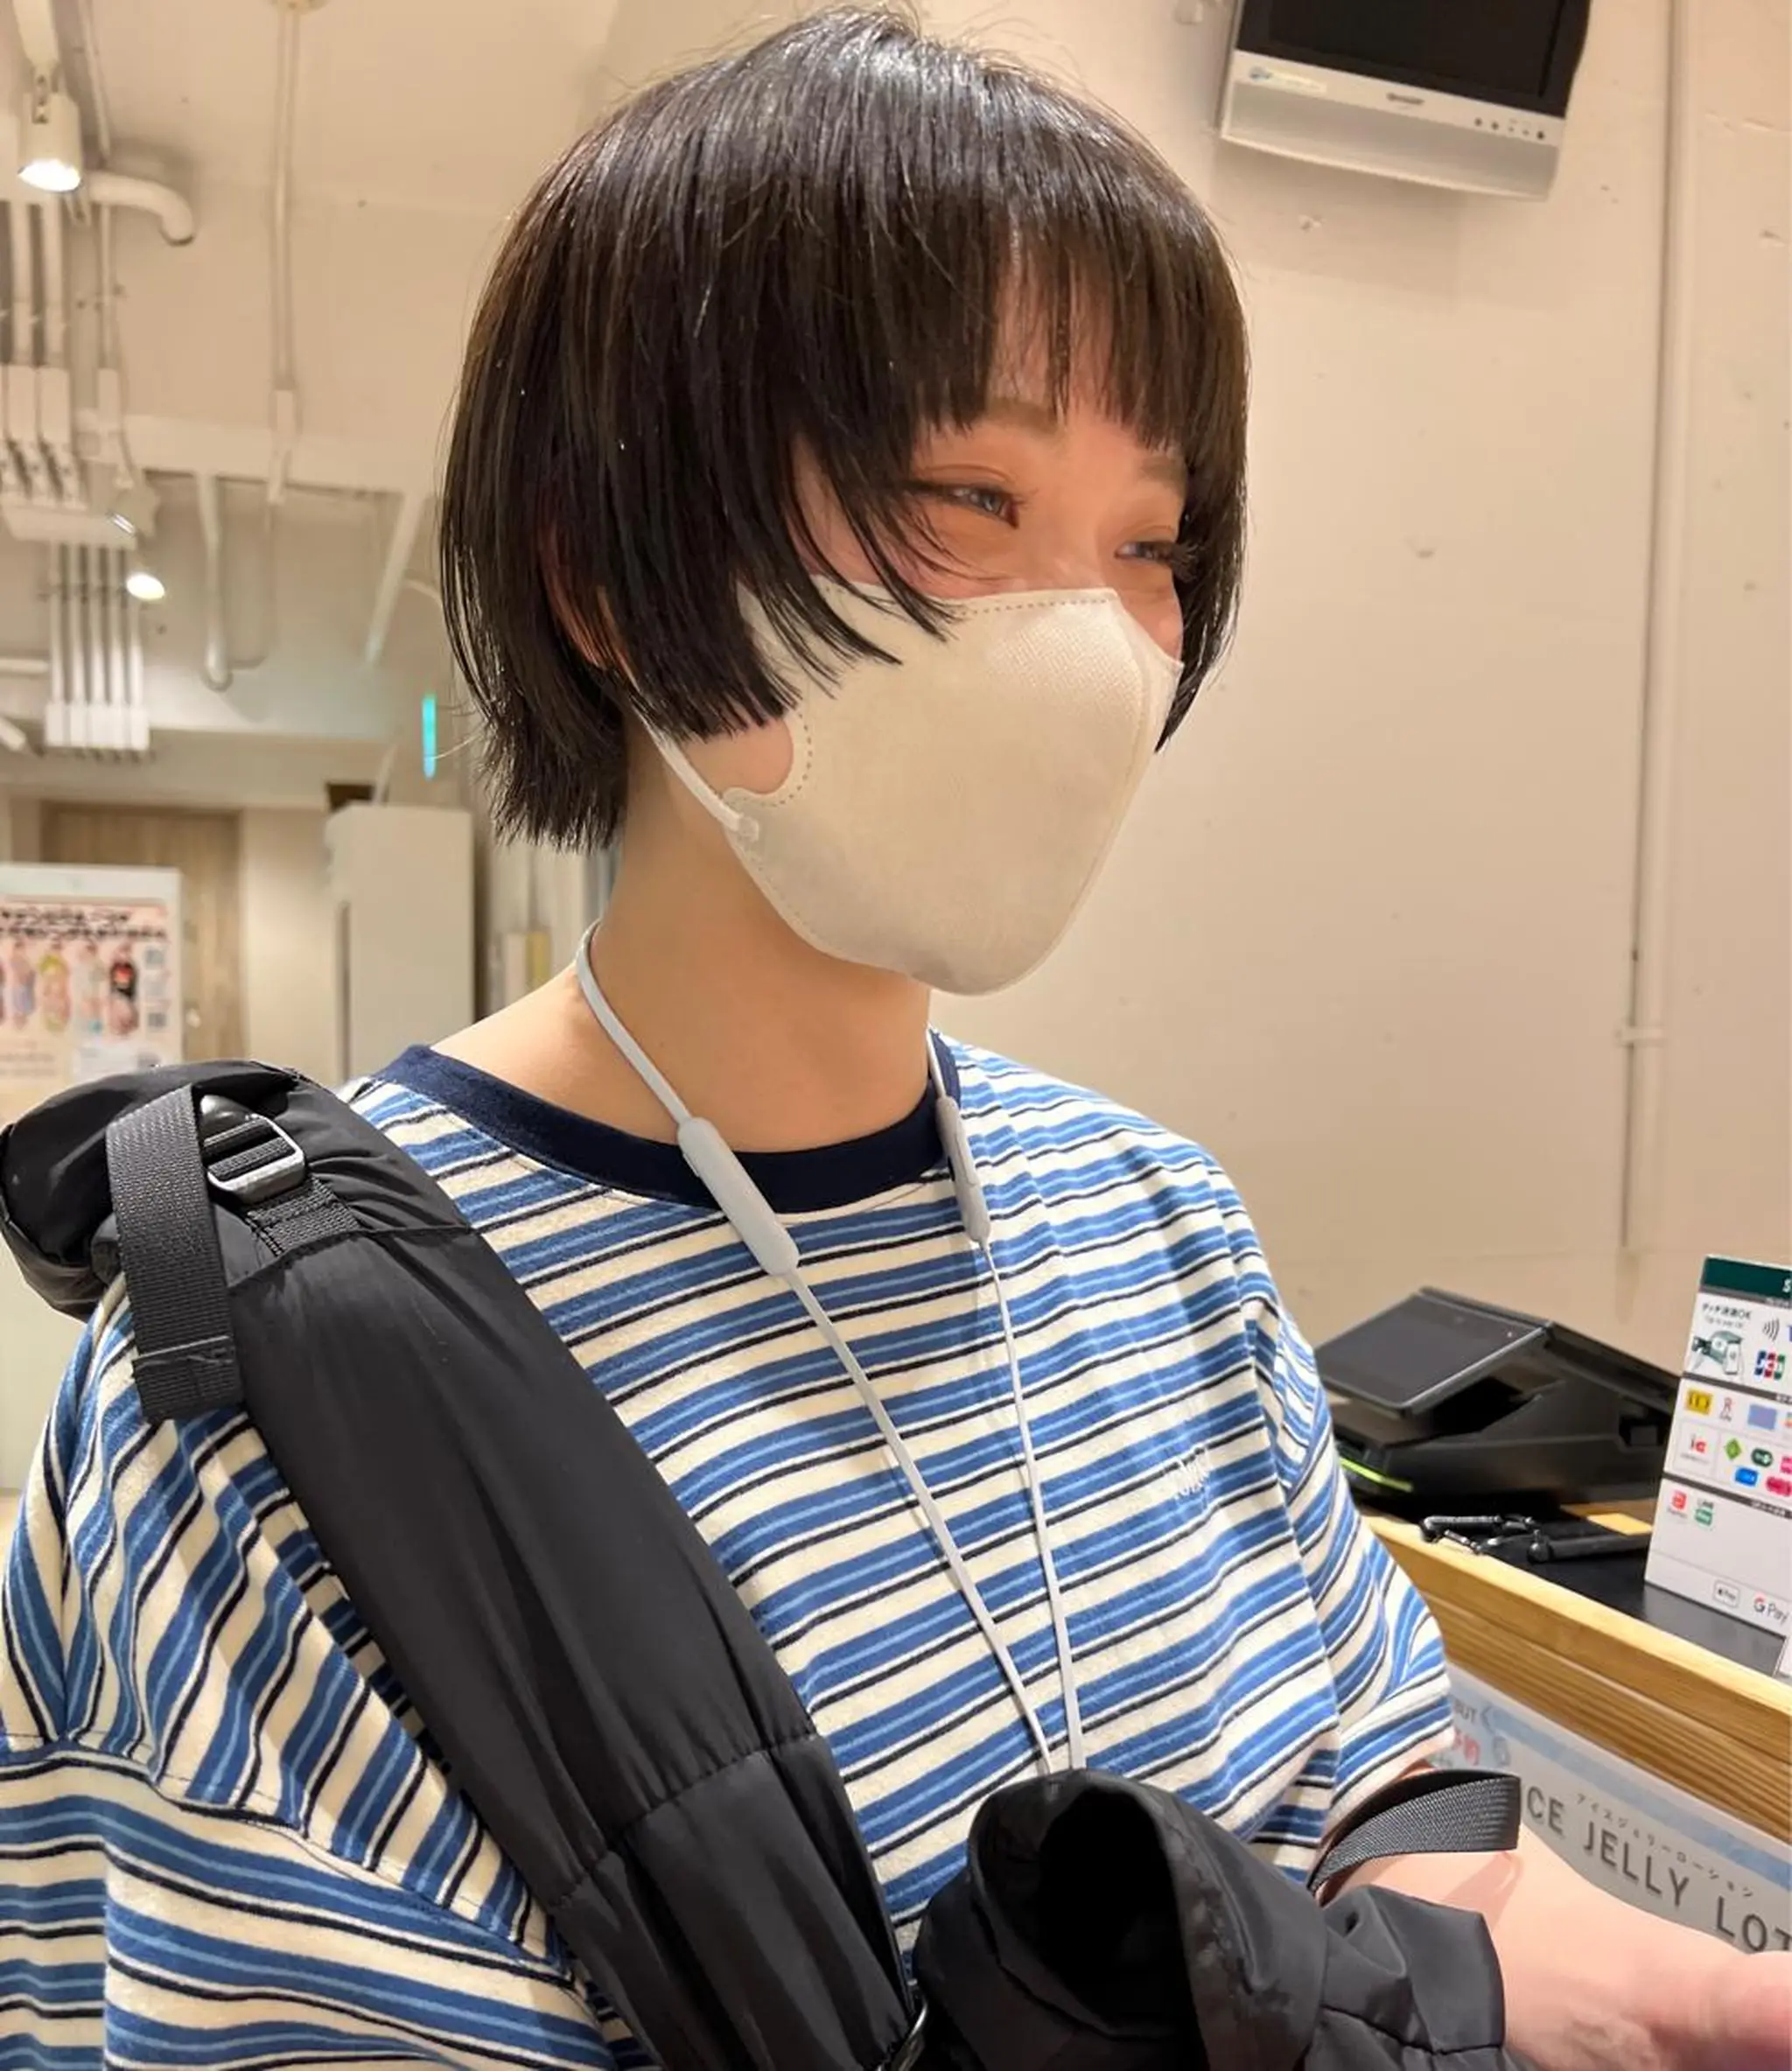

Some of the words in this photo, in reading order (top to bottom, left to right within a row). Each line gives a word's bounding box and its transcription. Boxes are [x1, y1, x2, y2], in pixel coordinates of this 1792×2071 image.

[1754, 1350, 1786, 1380] JCB
[1768, 1602, 1789, 1626] Pay
[1583, 1821, 1690, 1907] JELLY
